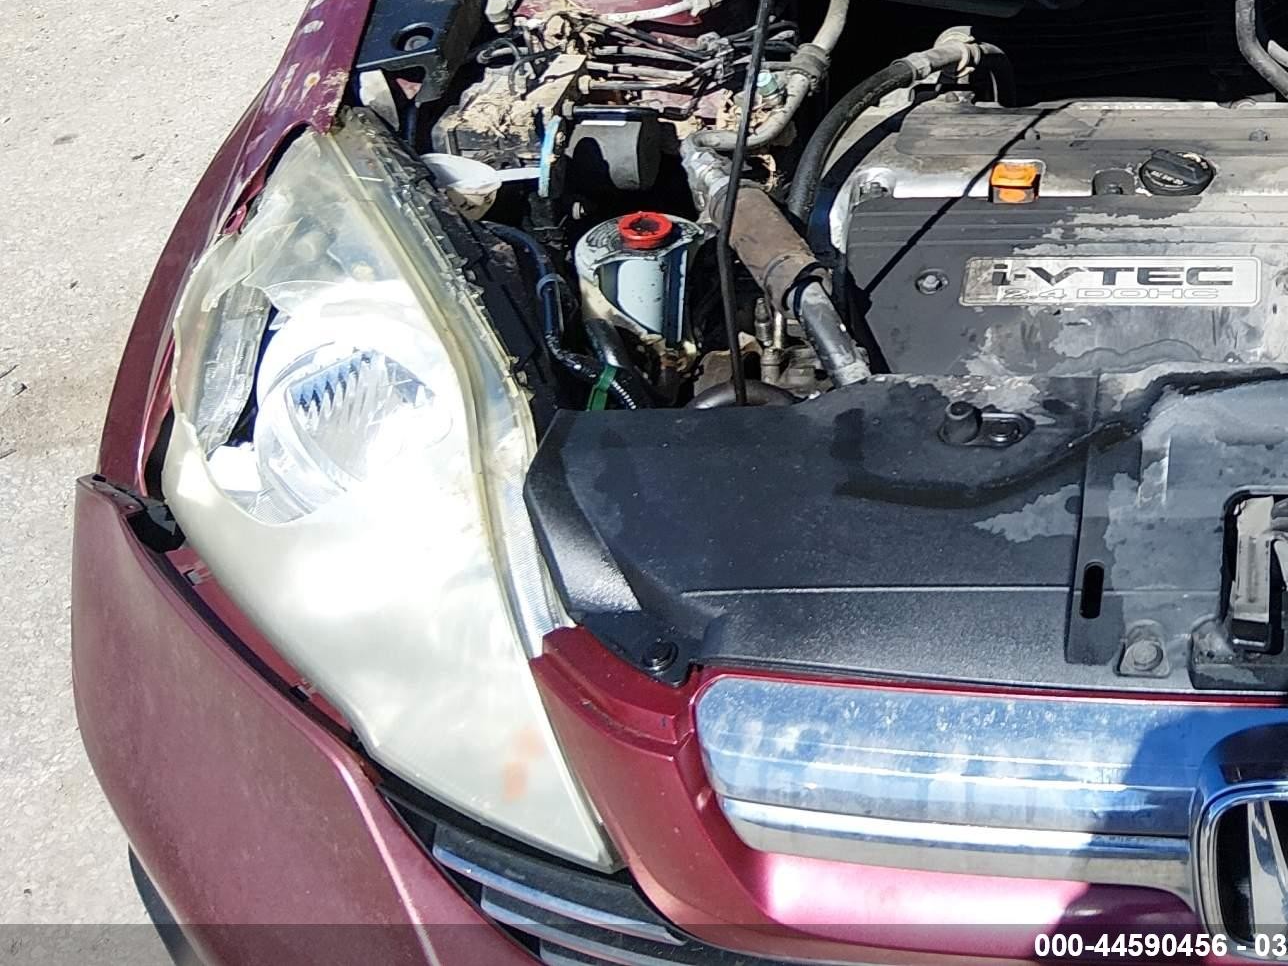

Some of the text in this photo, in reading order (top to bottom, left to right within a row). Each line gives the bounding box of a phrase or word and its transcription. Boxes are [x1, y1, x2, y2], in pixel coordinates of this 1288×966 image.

[991, 263, 1234, 287] i-VTEC
[1003, 288, 1219, 300] 2.4 DOHC
